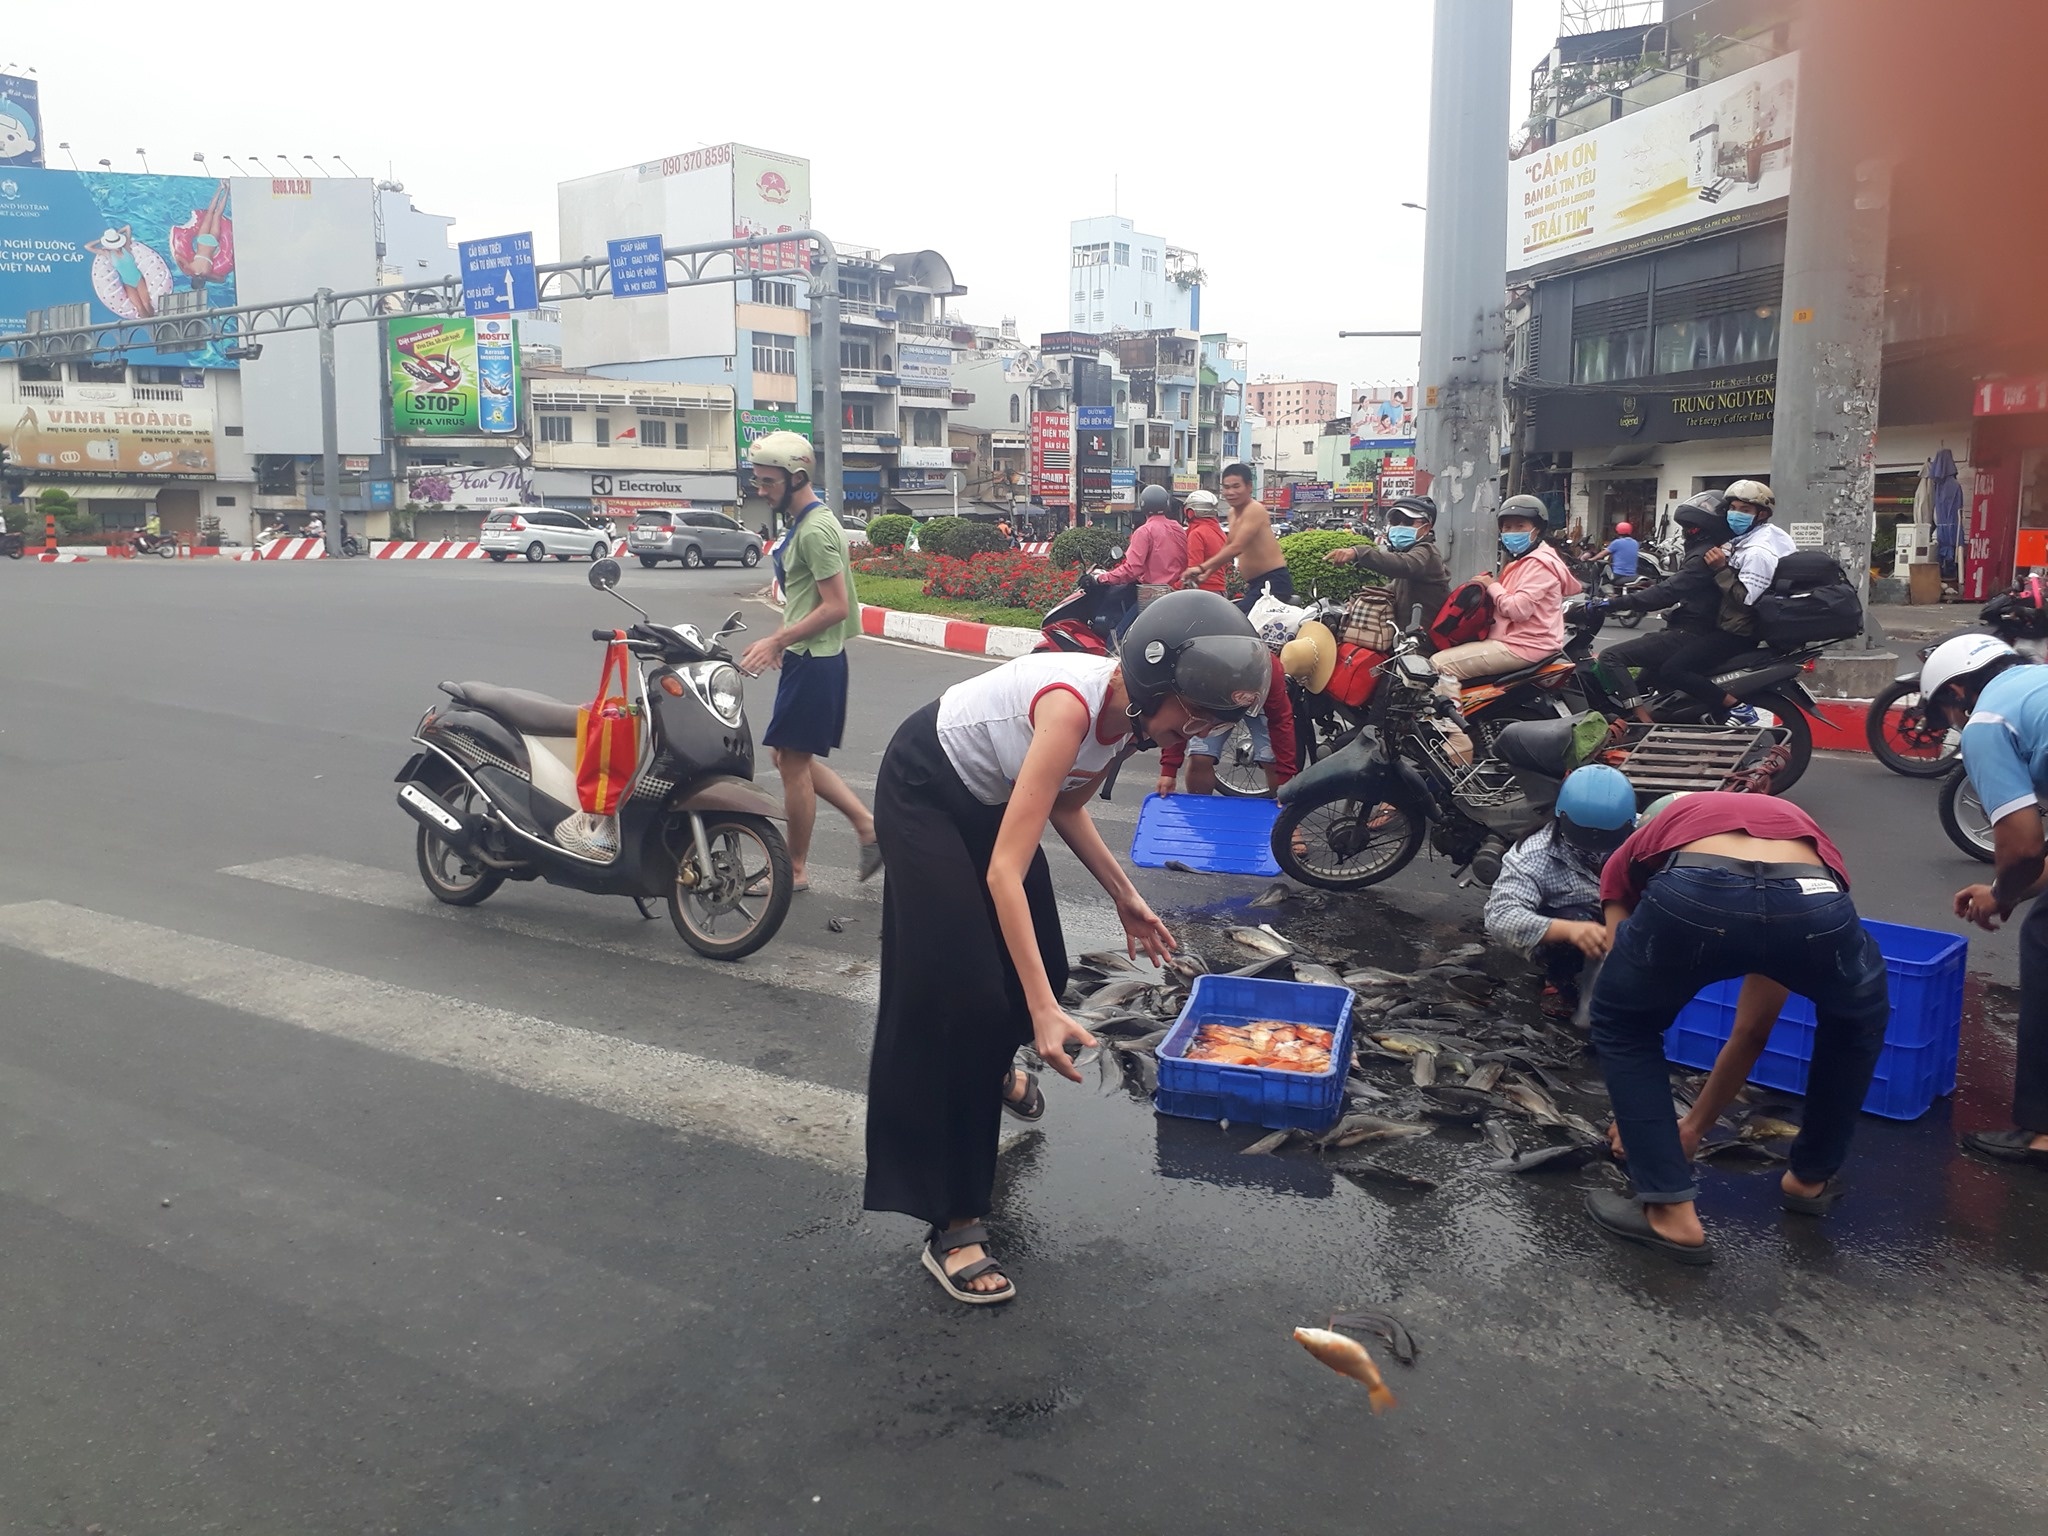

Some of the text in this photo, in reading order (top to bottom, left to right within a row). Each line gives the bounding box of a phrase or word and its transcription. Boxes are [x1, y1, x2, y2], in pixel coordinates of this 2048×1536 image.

[662, 157, 681, 176] 090
[684, 152, 702, 172] 370
[705, 145, 731, 166] 8596
[1572, 140, 1597, 168] ƠN
[1524, 187, 1543, 206] BẠN
[1559, 176, 1574, 193] TIN
[1577, 167, 1596, 187] YÊU
[1532, 213, 1562, 242] TRÁI
[11, 251, 84, 262] HỢP CAO CẤP
[26, 264, 51, 273] NAM
[477, 333, 510, 341] MOSFLY
[1710, 380, 1725, 390] THE
[1755, 373, 1775, 384] COF
[415, 395, 460, 411] STOP
[1672, 395, 1714, 414] TRUNG
[1980, 383, 1993, 412] 1
[48, 408, 192, 427] VINH HOÀNG
[435, 418, 466, 426] VIRUS
[1686, 417, 1697, 426] The
[1699, 416, 1721, 427] Energy
[1724, 413, 1747, 424] Coffee
[1750, 411, 1765, 422] That
[1058, 429, 1069, 438] THO
[619, 480, 682, 493] Electrolux
[608, 507, 627, 516] 20%
[1978, 499, 1988, 531] 1
[1972, 567, 1984, 598] 1
[1716, 671, 1740, 684] RIUS
